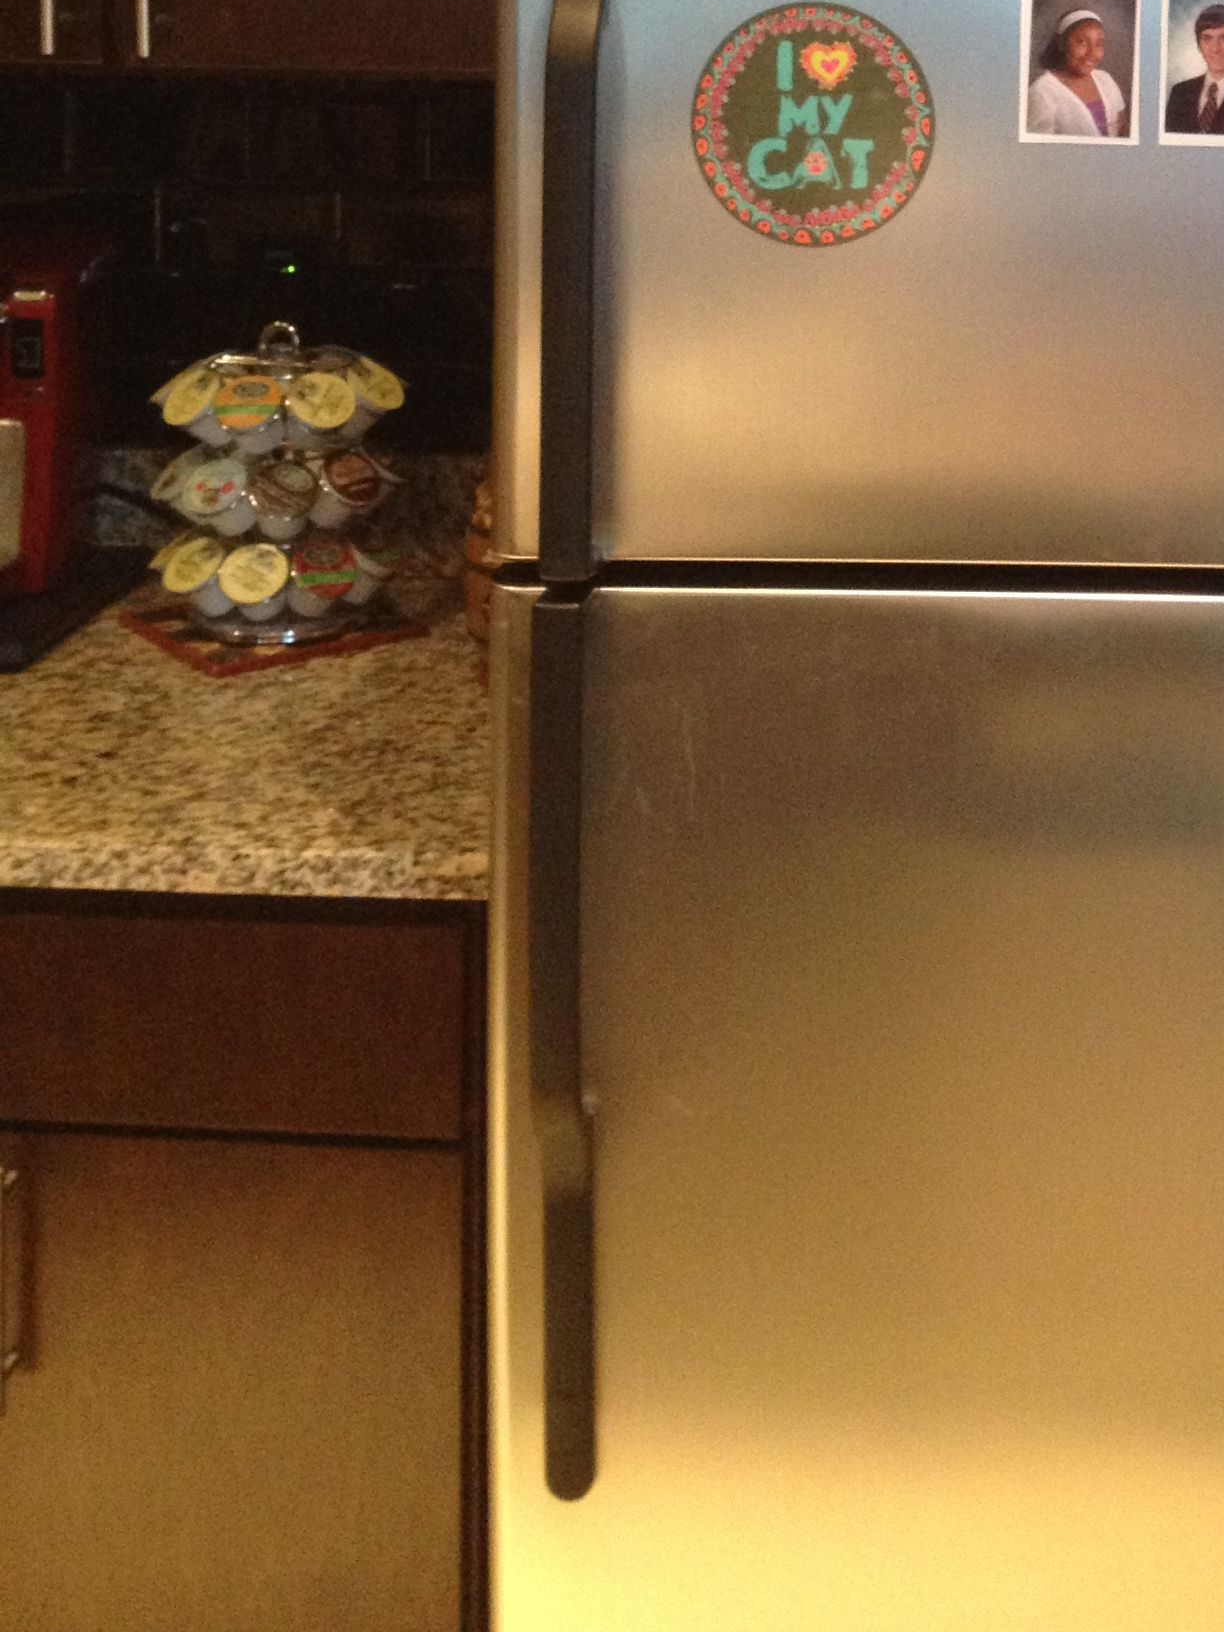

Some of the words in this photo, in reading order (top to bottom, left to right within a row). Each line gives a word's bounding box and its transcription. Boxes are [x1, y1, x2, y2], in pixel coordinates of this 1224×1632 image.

[776, 40, 794, 91] I
[777, 92, 853, 136] MY
[747, 136, 875, 190] CAT
